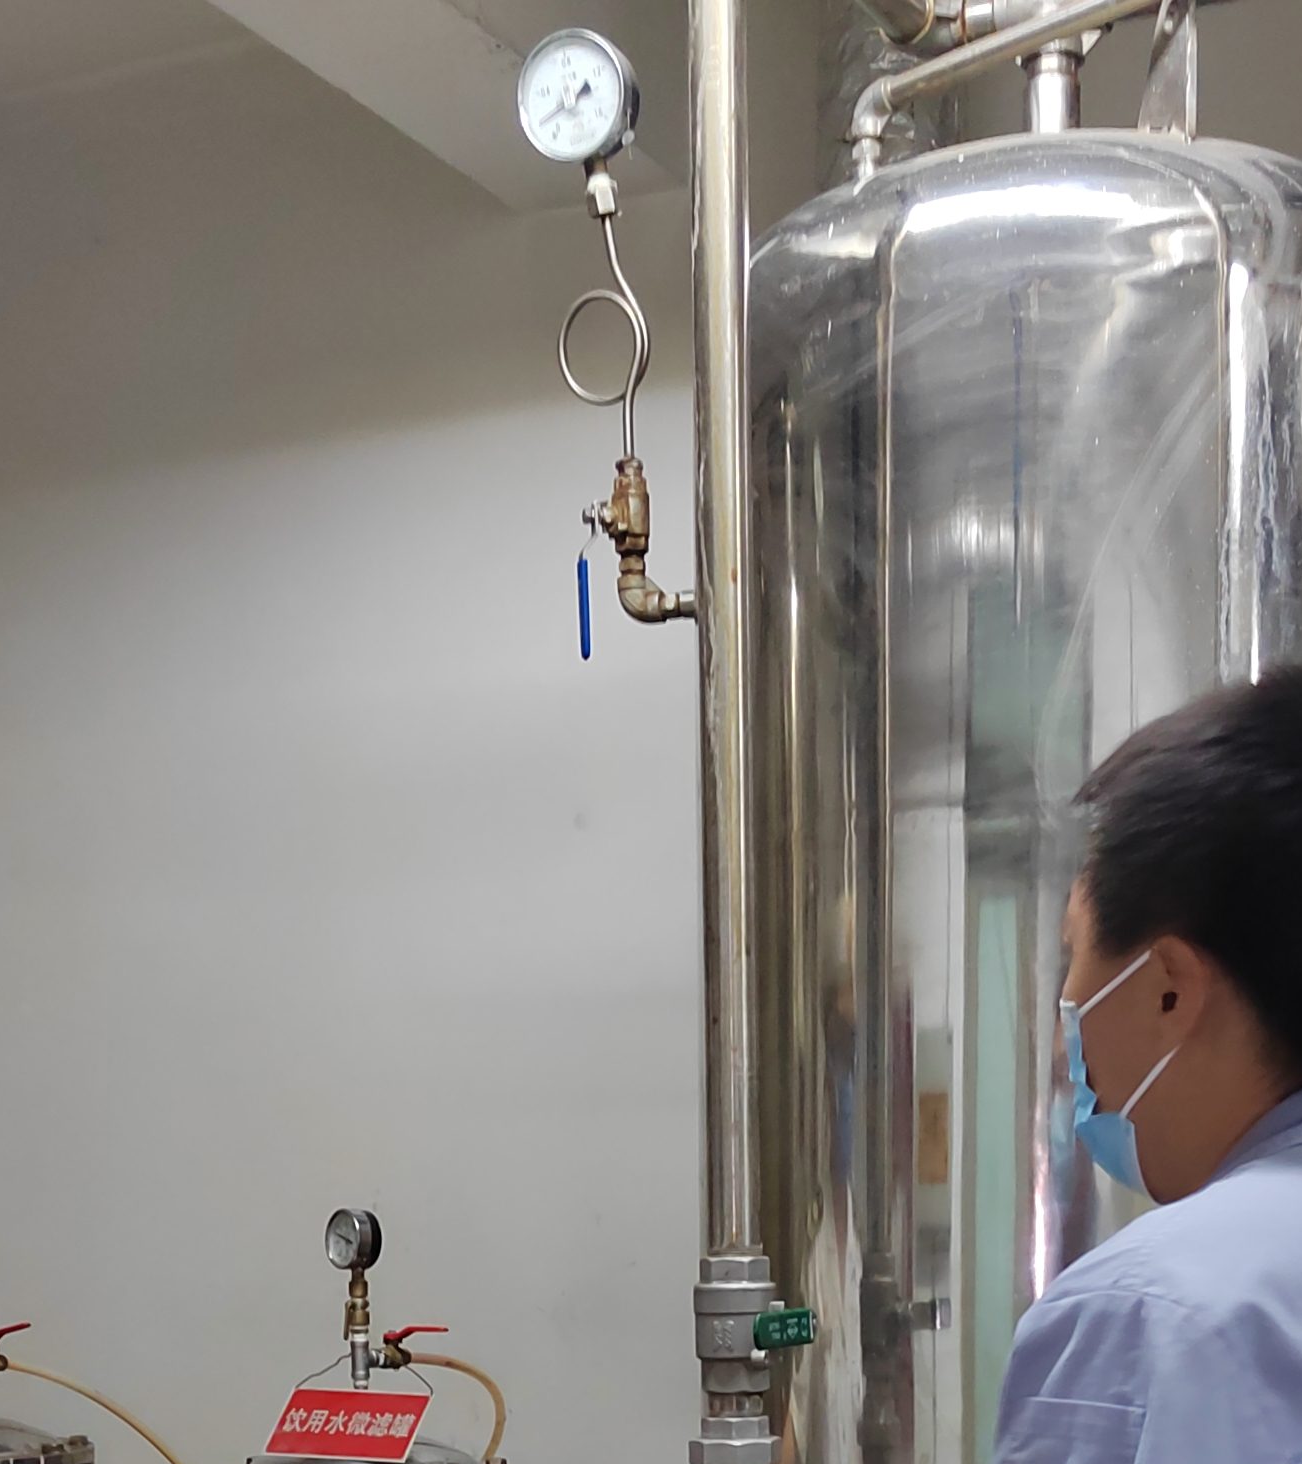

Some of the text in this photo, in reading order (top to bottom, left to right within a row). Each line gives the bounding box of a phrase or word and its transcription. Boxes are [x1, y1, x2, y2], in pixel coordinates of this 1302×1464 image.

[282, 1407, 416, 1438] 饮用水微滤罐
